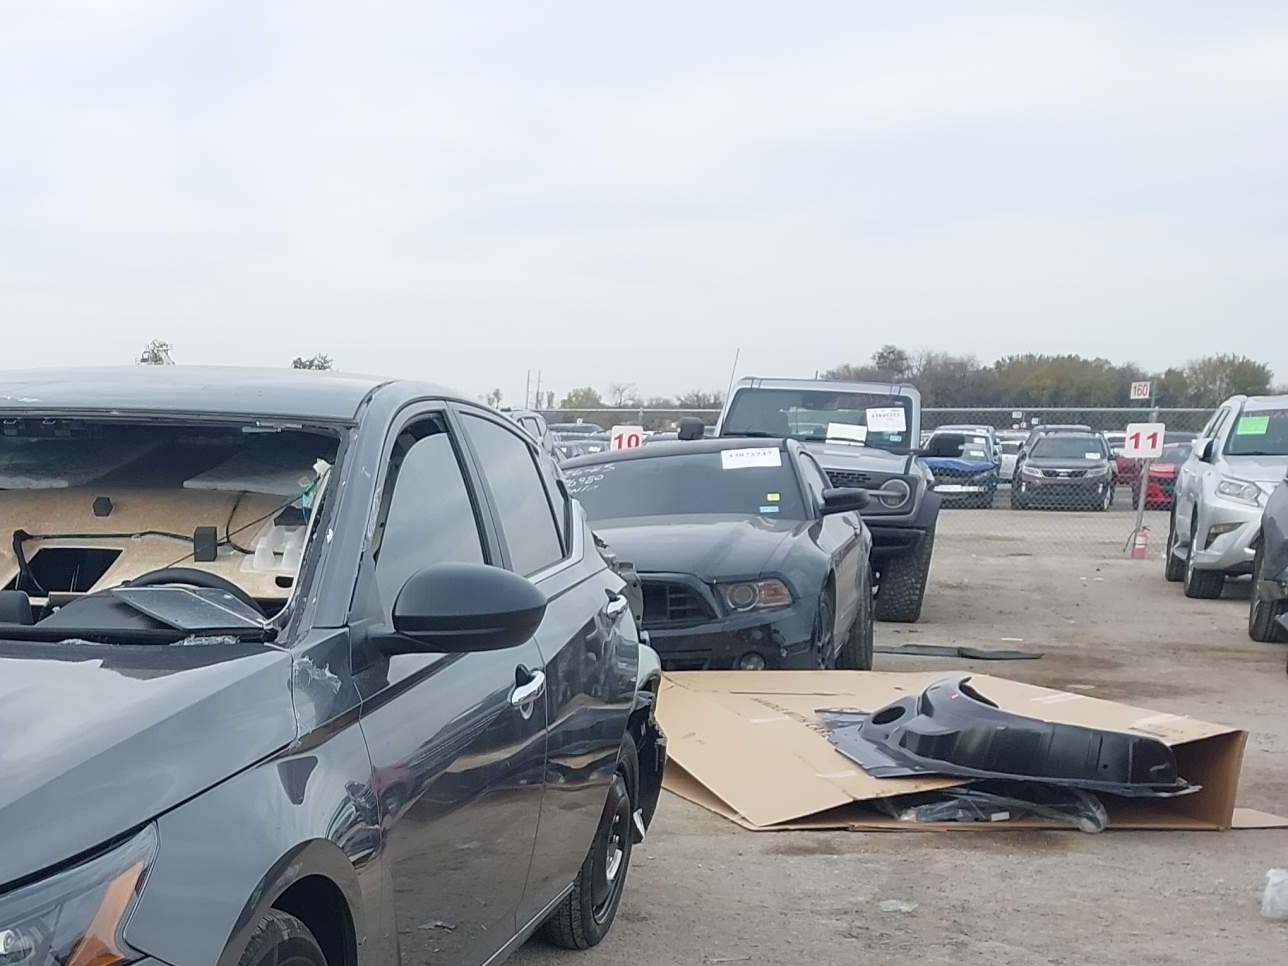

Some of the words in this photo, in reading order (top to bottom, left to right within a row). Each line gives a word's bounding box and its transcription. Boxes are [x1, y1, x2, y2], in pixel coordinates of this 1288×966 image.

[1134, 384, 1149, 397] 160
[614, 434, 640, 450] 10
[1129, 432, 1158, 449] 11
